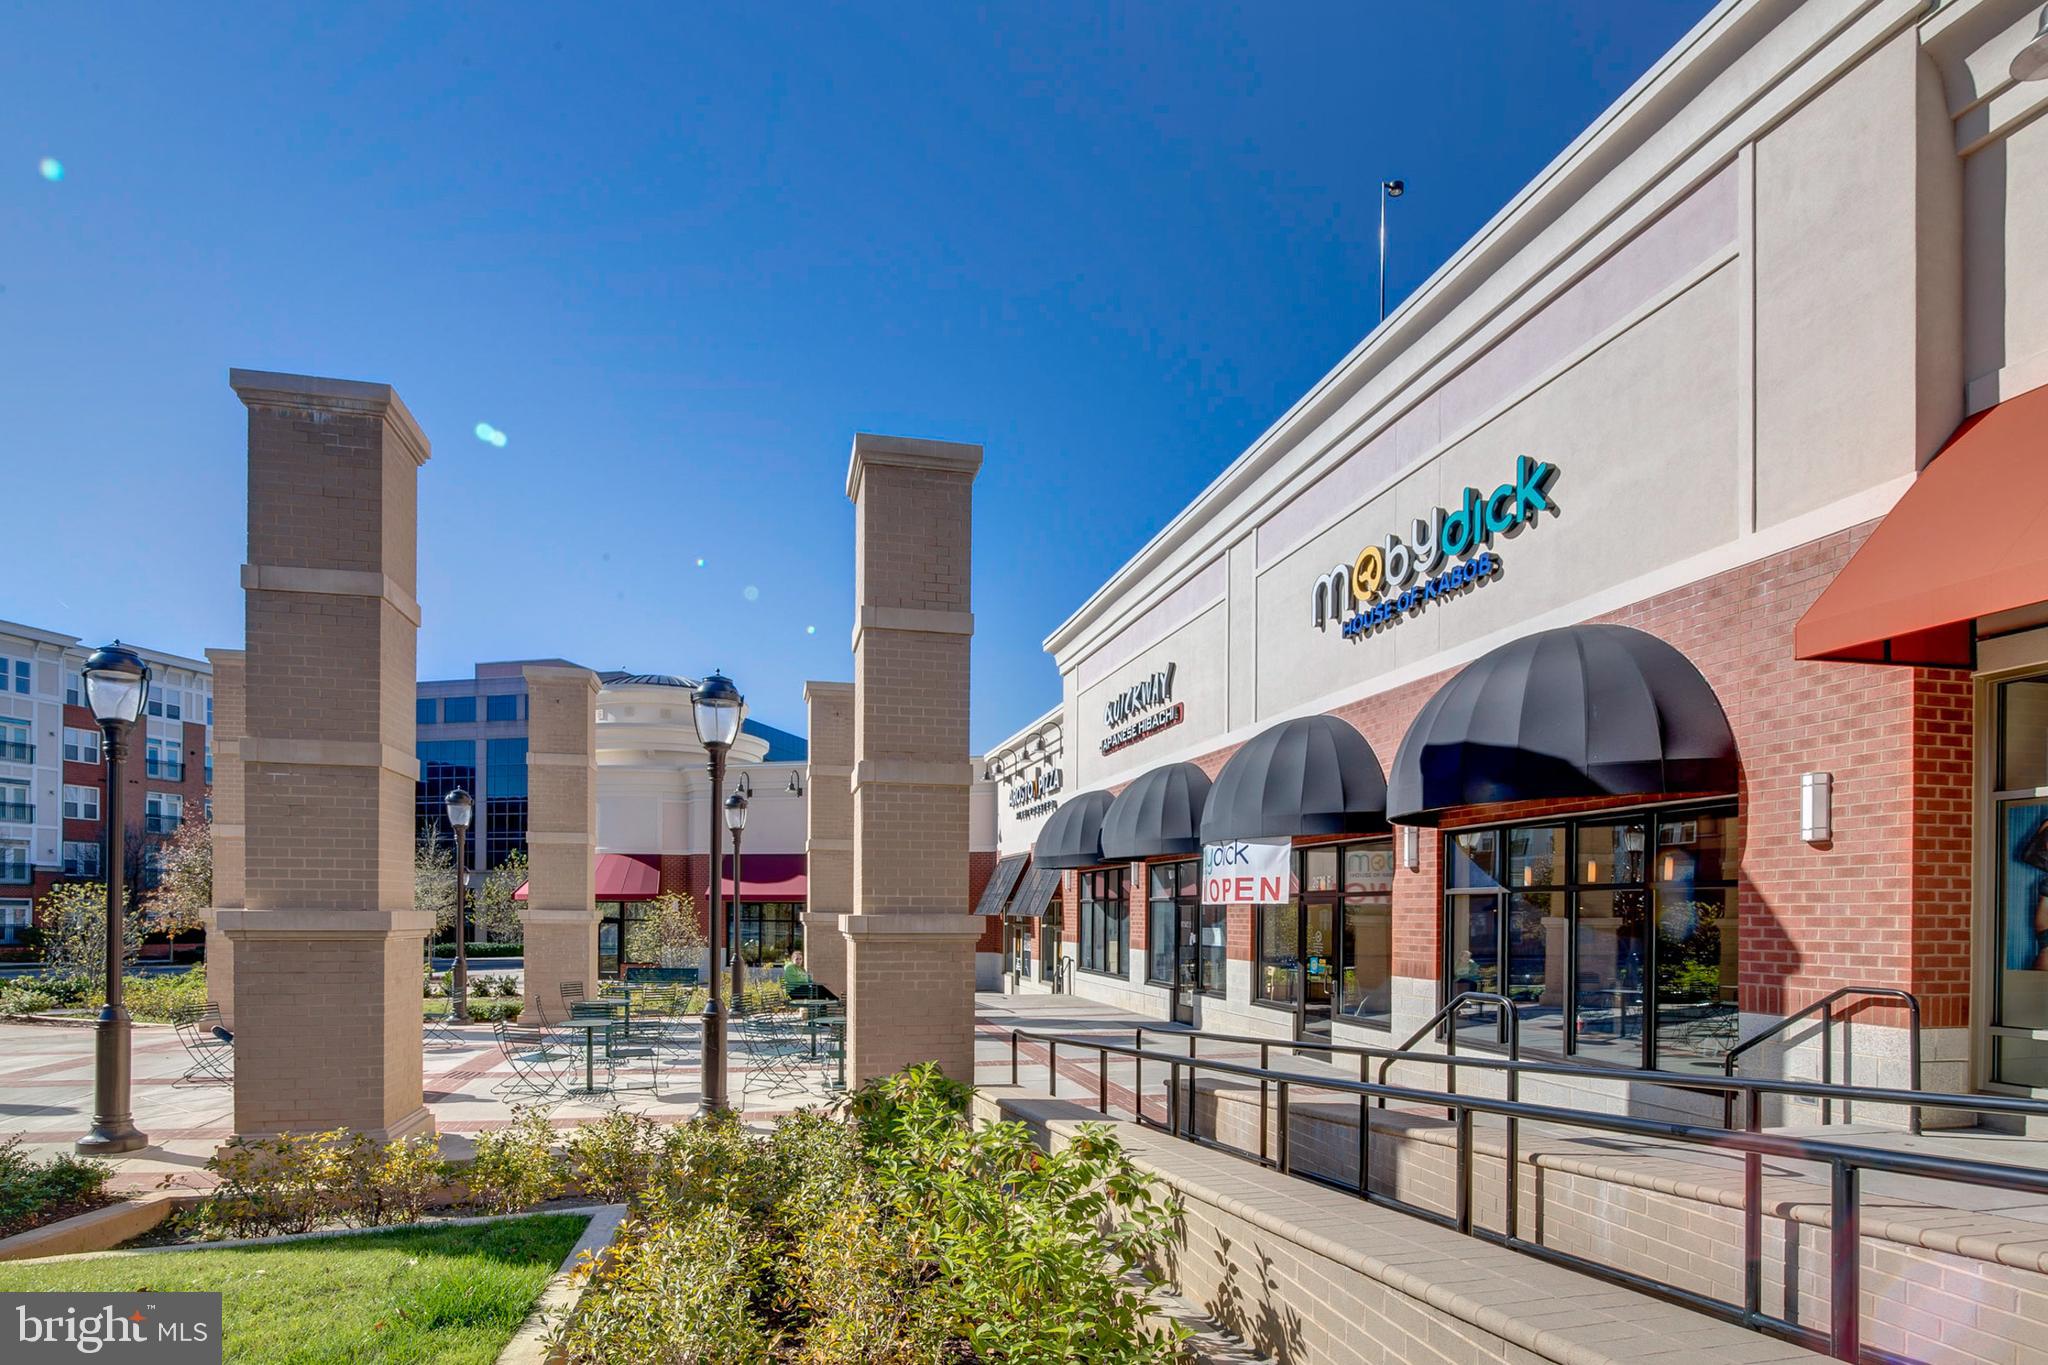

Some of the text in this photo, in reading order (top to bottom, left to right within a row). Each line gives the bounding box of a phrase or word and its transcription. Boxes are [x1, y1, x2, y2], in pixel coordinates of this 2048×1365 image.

[1342, 552, 1497, 640] HOUSE OF KABOB
[1104, 663, 1174, 728] QUICKWAY
[1101, 706, 1175, 751] APANESE HIBACHI
[1038, 768, 1061, 797] PIZZA
[1209, 876, 1281, 903] OPEN
